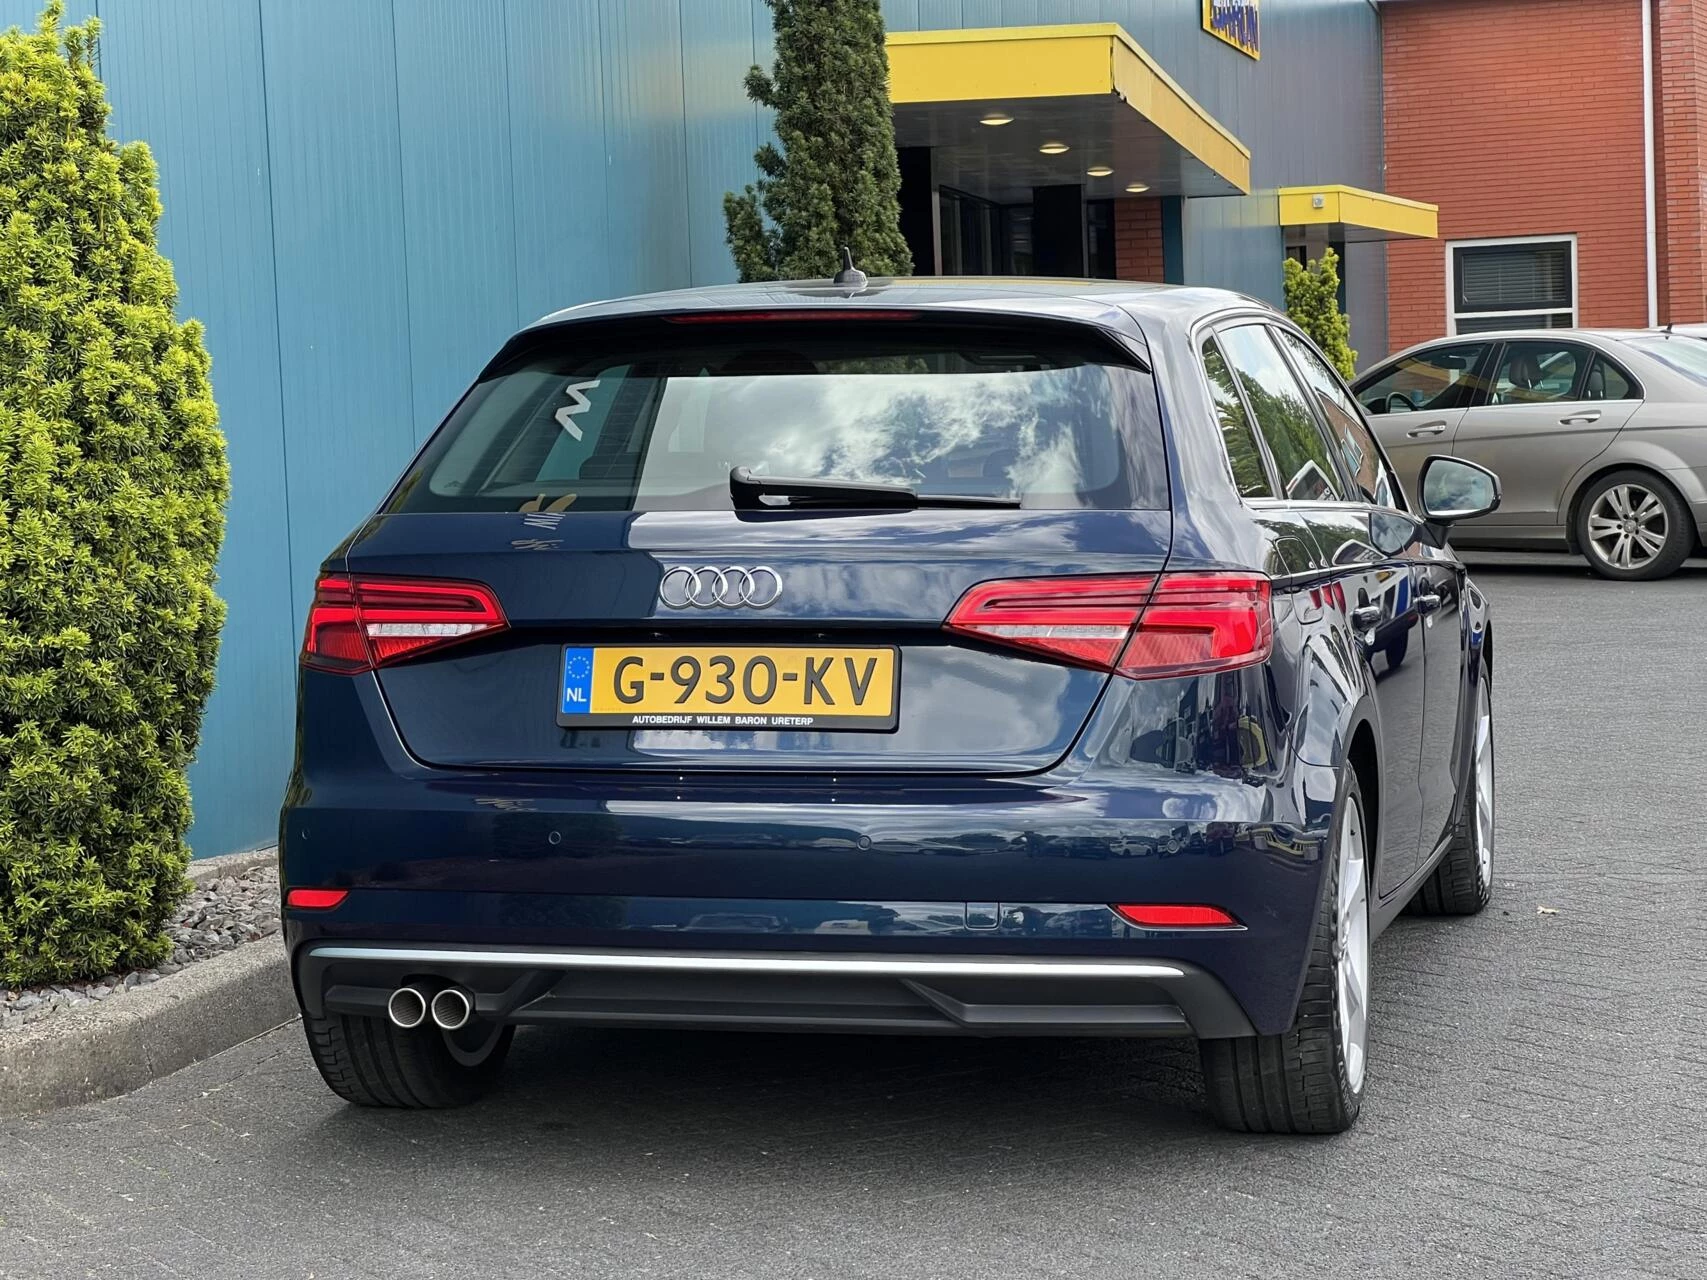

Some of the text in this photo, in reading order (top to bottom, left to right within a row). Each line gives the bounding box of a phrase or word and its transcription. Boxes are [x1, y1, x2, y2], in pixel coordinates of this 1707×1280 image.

[613, 655, 878, 706] G-930-KV
[566, 687, 587, 702] NL
[632, 715, 814, 726] AUTOBEDRIJF WILLEM BARON URETERP
